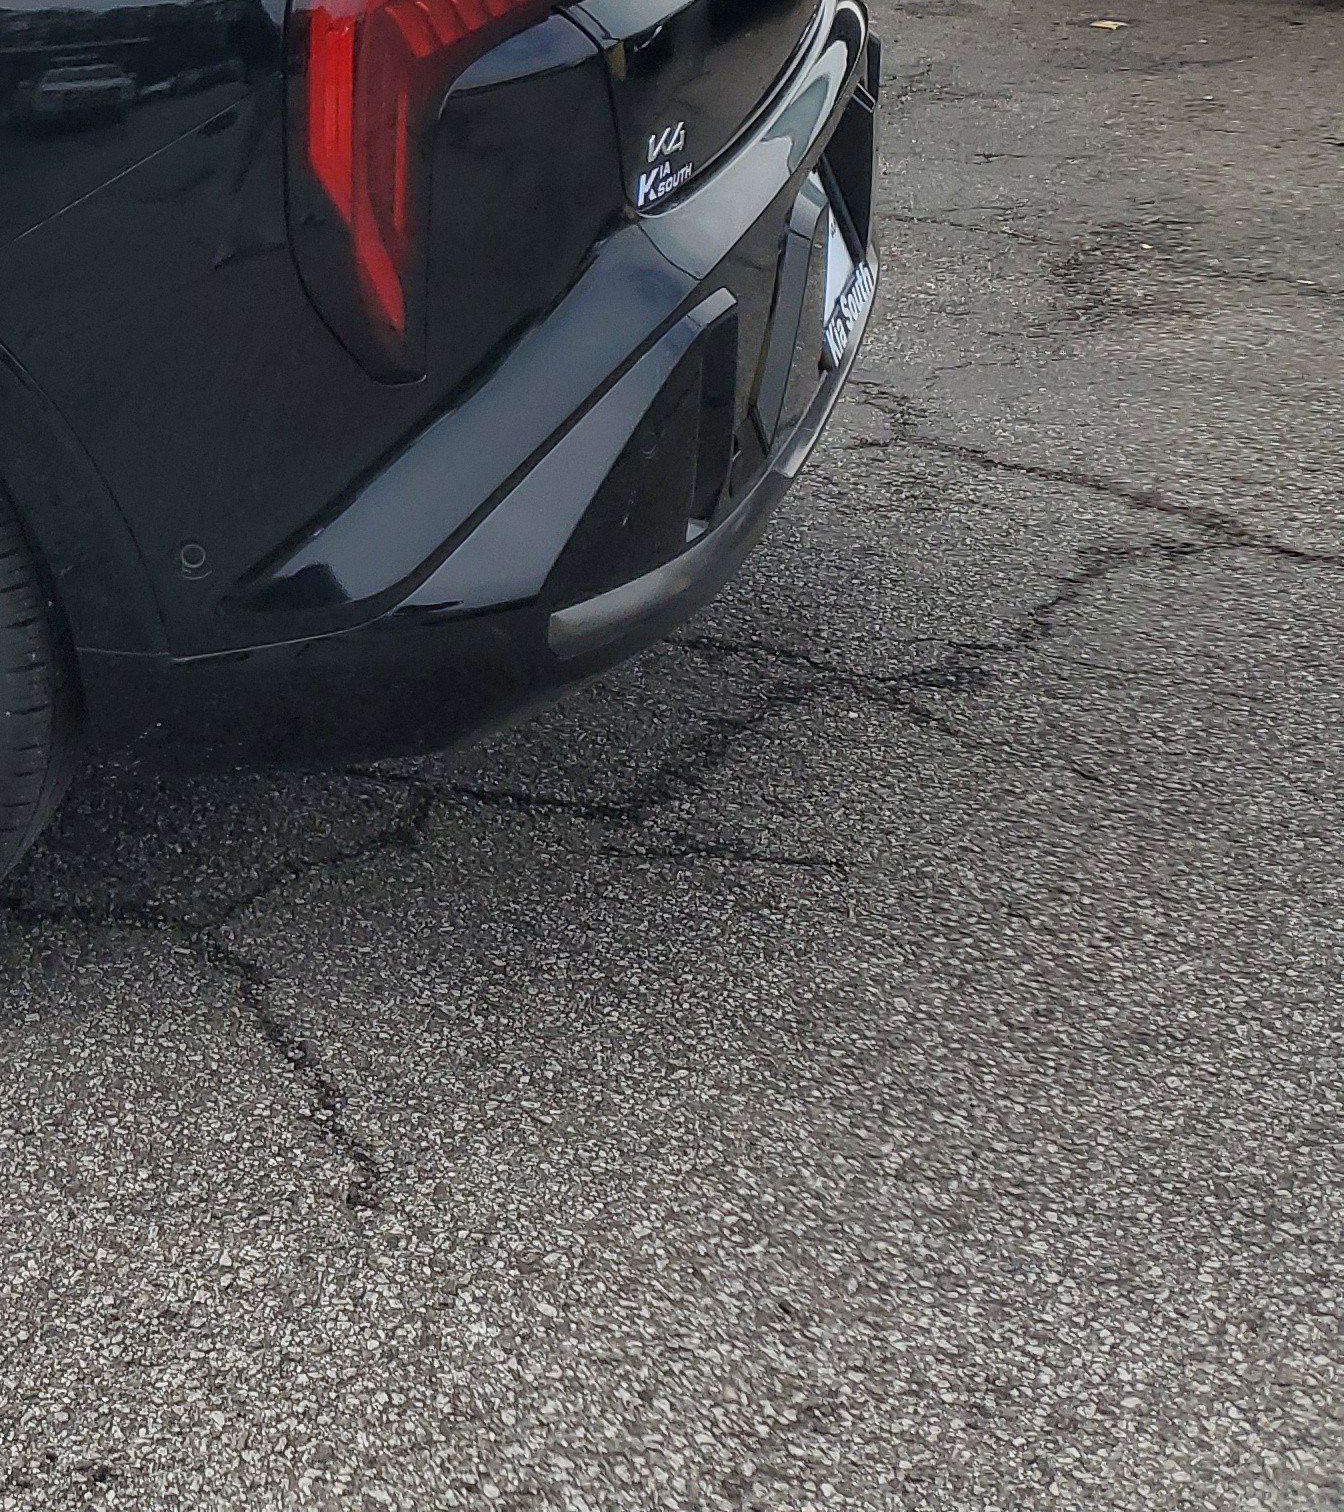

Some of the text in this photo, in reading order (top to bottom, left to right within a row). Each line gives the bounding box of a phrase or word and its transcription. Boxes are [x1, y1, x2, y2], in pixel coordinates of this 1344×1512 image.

[648, 121, 685, 163] K4
[638, 161, 671, 206] KIA
[657, 162, 692, 197] SOUTH
[825, 262, 874, 367] Kia South
